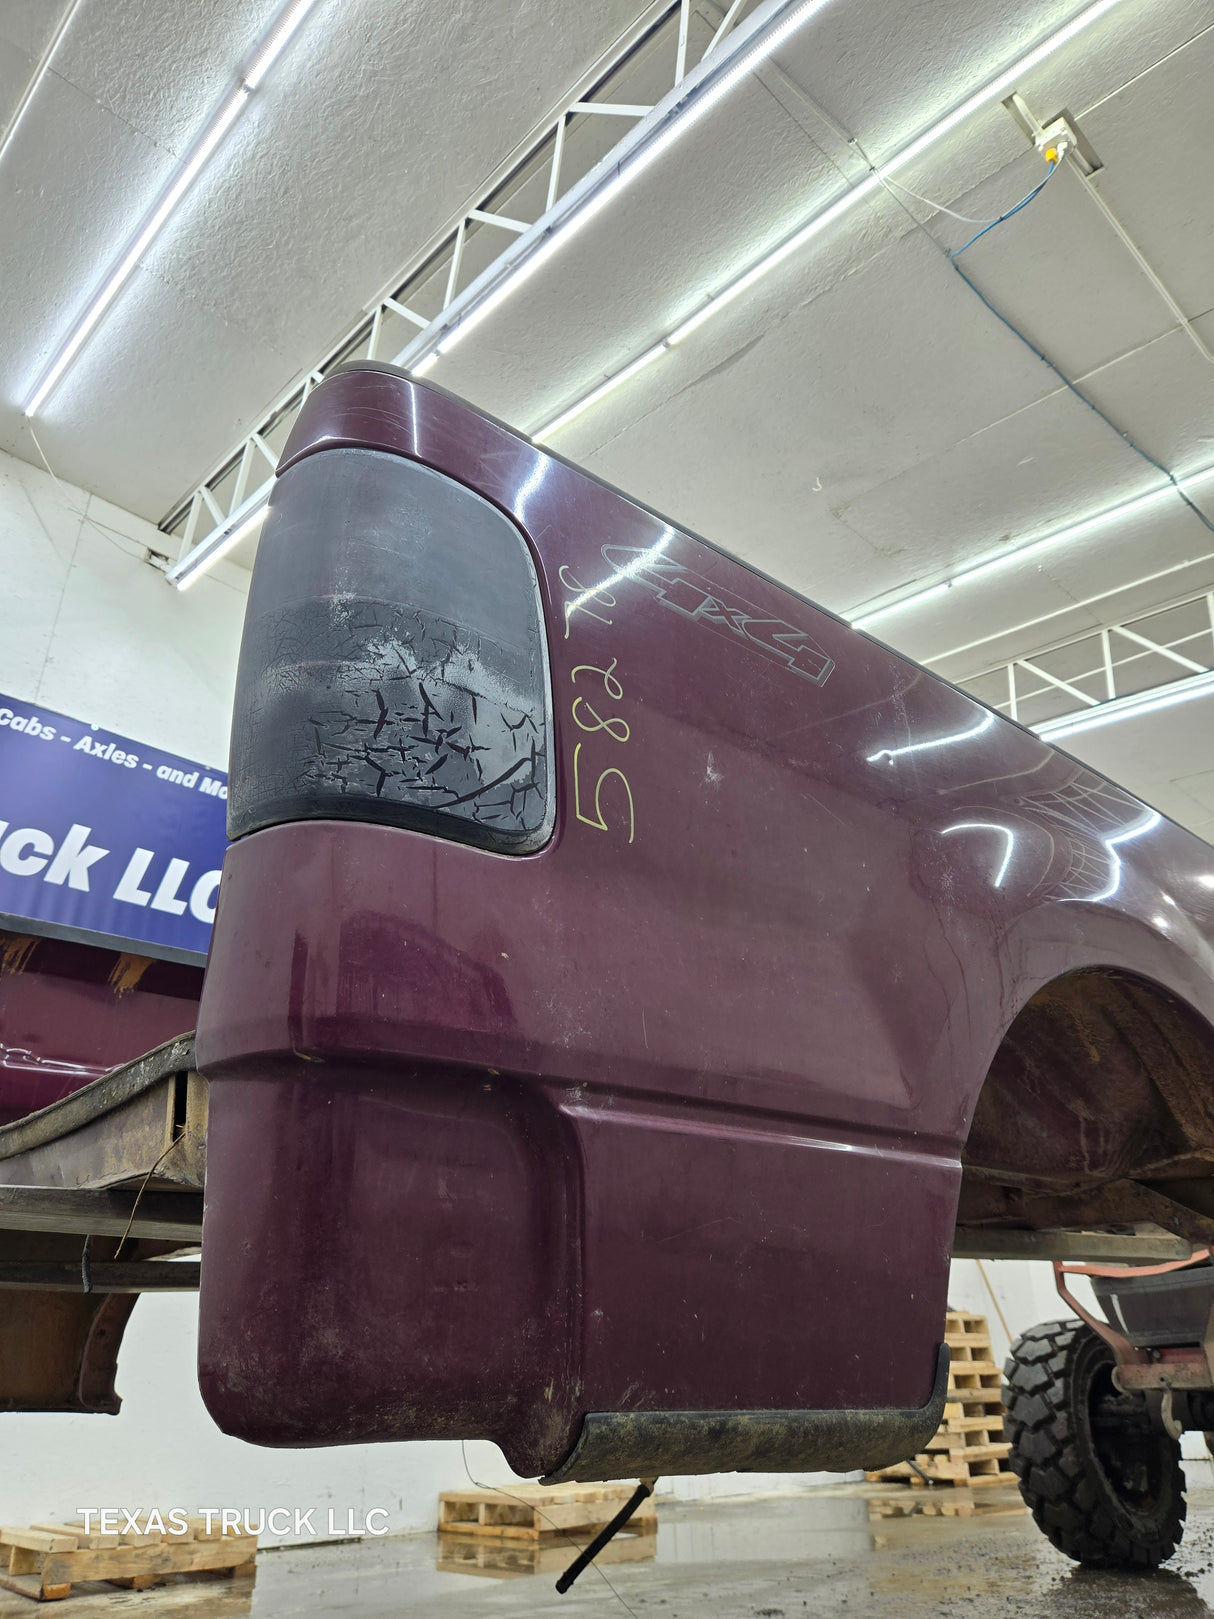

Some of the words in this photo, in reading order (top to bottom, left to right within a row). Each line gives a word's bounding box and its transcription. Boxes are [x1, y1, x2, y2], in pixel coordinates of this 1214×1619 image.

[601, 544, 834, 687] 4x4
[0, 707, 57, 741] Cabs
[73, 735, 140, 769] Axles
[155, 765, 200, 789] and
[0, 819, 111, 893] ck
